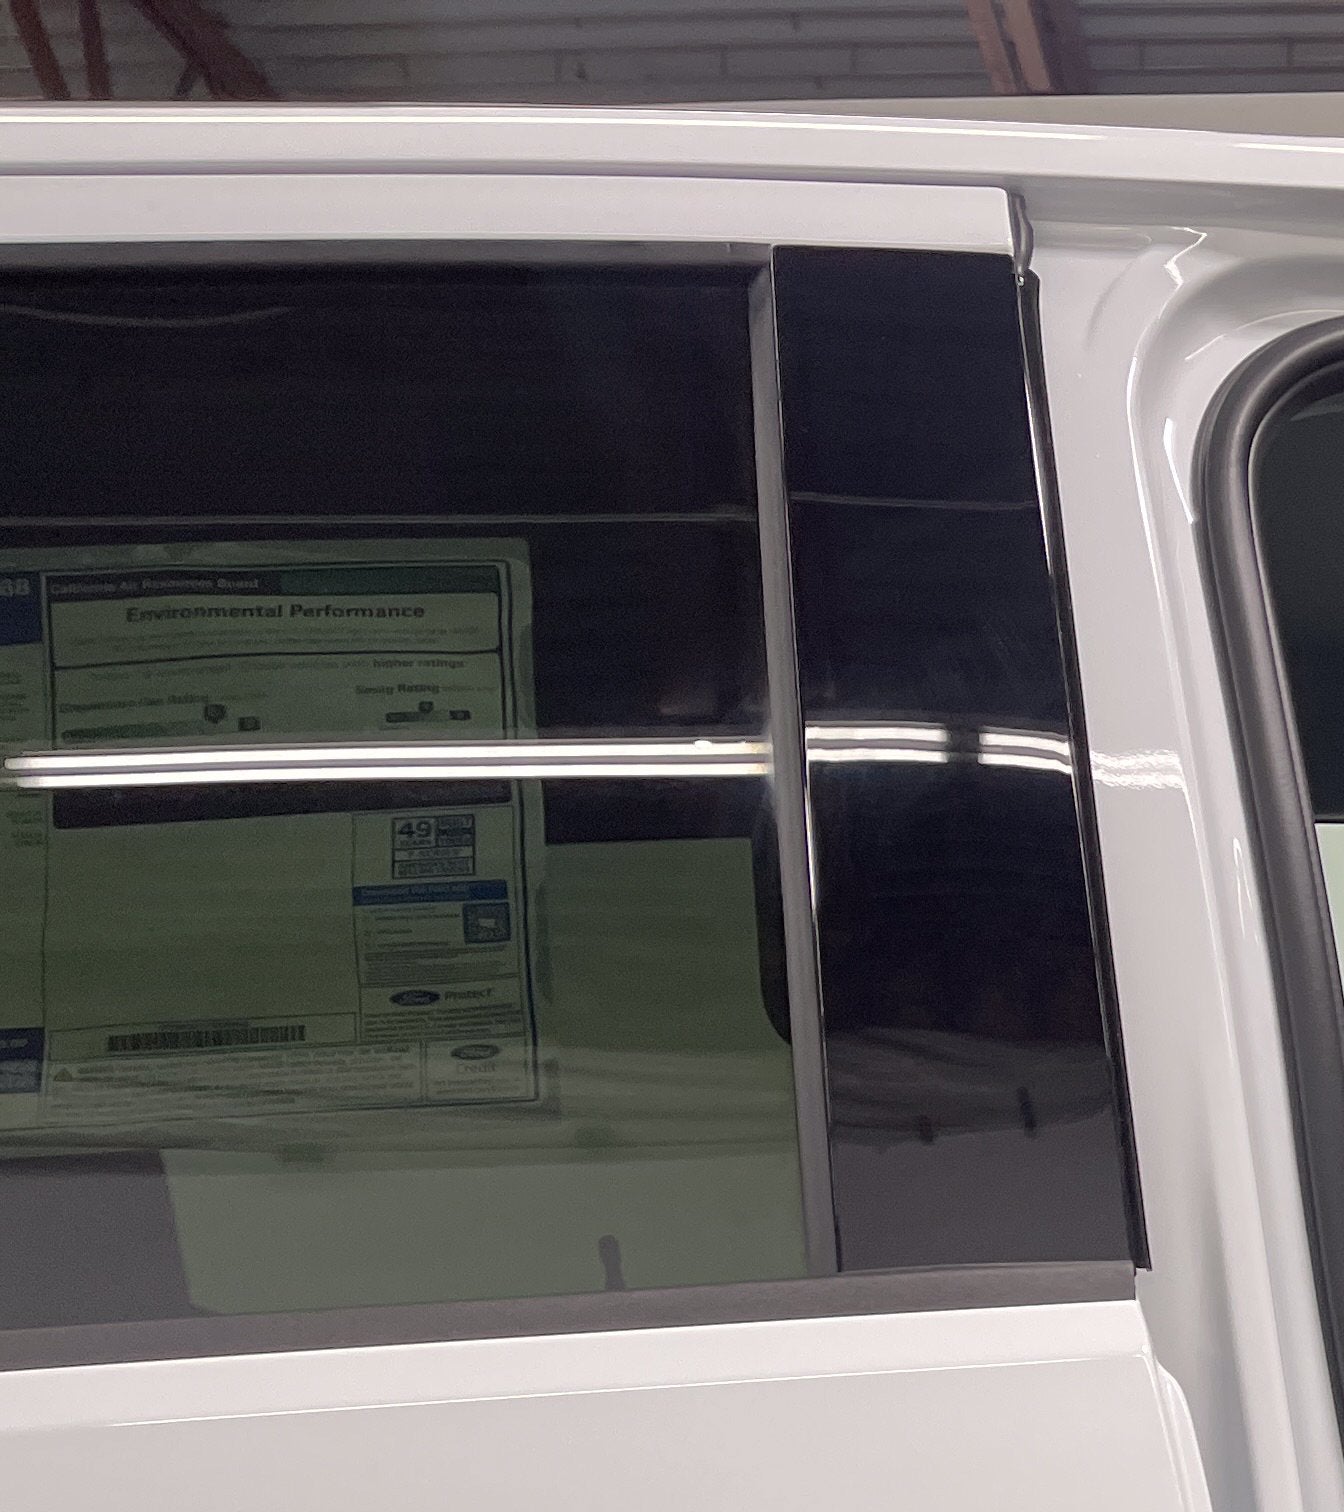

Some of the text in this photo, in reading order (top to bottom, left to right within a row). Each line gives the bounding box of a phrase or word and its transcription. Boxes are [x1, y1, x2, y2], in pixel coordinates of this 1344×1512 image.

[126, 604, 425, 622] Environmental Performance
[398, 821, 432, 838] 49
